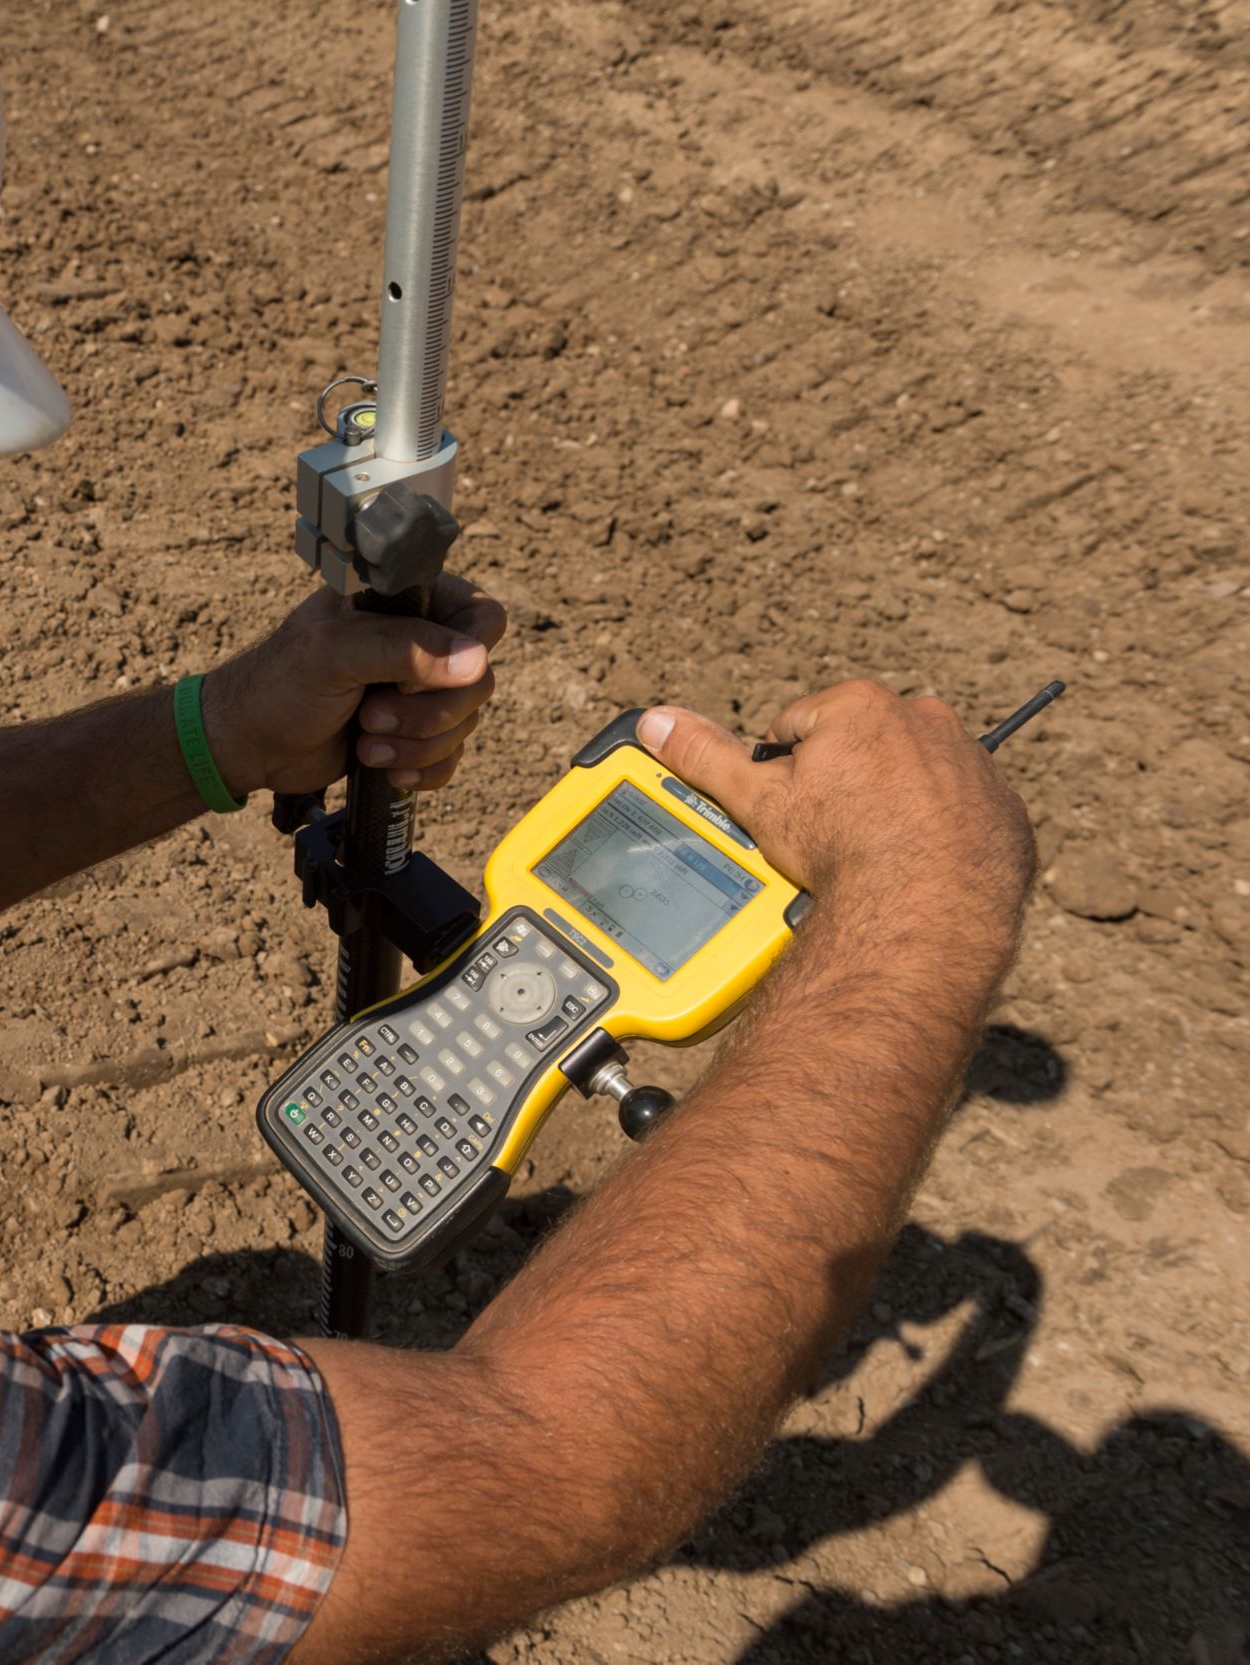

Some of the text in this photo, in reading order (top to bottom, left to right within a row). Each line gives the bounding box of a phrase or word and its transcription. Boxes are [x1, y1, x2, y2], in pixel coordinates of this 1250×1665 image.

[696, 801, 731, 831] Trimble
[569, 928, 587, 946] TSC2
[565, 1001, 579, 1013] ESC
[359, 1039, 370, 1052] Fn
[380, 1026, 395, 1042] CTRL
[343, 1059, 351, 1067] E
[382, 1099, 390, 1107] G
[401, 1119, 410, 1128] H
[379, 1062, 450, 1131] A B C D
[325, 1075, 333, 1083] K
[344, 1095, 350, 1103] L
[363, 1115, 373, 1124] M
[382, 1136, 392, 1145] N
[308, 1092, 316, 1100] Q
[326, 1112, 334, 1121] R
[346, 1133, 354, 1142] S
[385, 1176, 394, 1184] U
[309, 1128, 377, 1203] W X Y Z
[338, 1244, 354, 1259] 80
